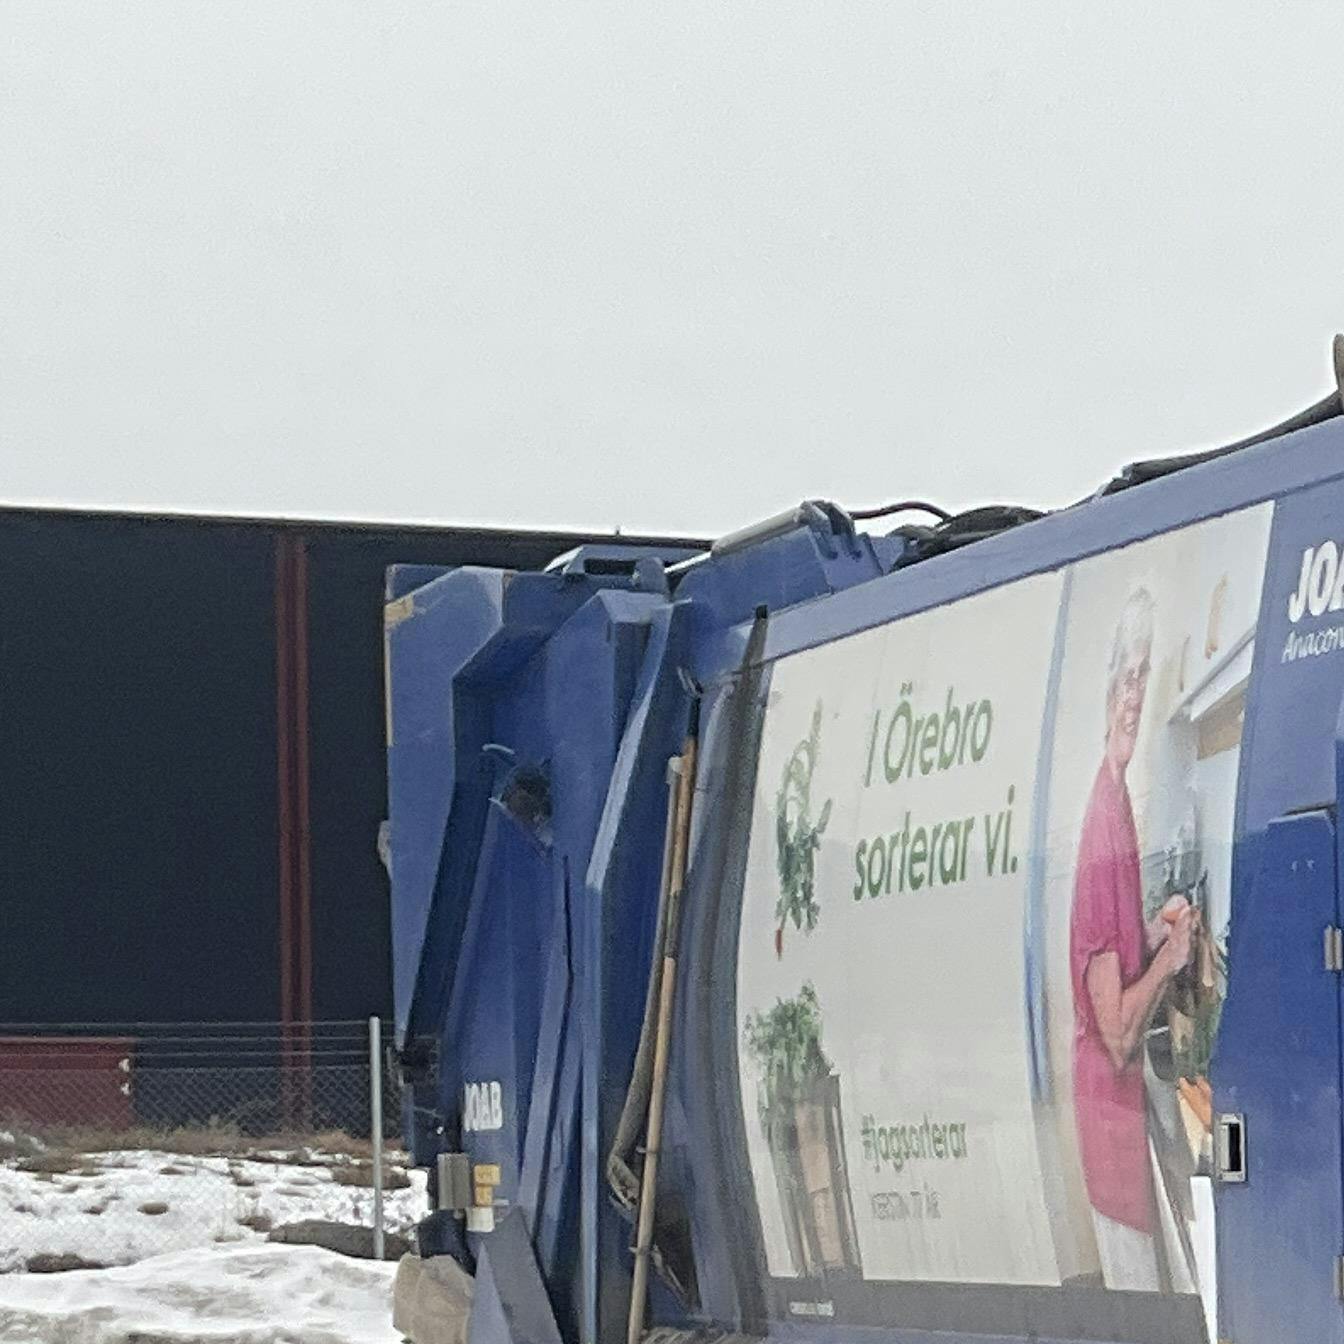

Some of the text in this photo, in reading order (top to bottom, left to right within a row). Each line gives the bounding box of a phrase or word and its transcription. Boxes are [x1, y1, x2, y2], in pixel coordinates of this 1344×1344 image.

[884, 680, 993, 784] Örebro
[853, 784, 1018, 901] sorterar vi.
